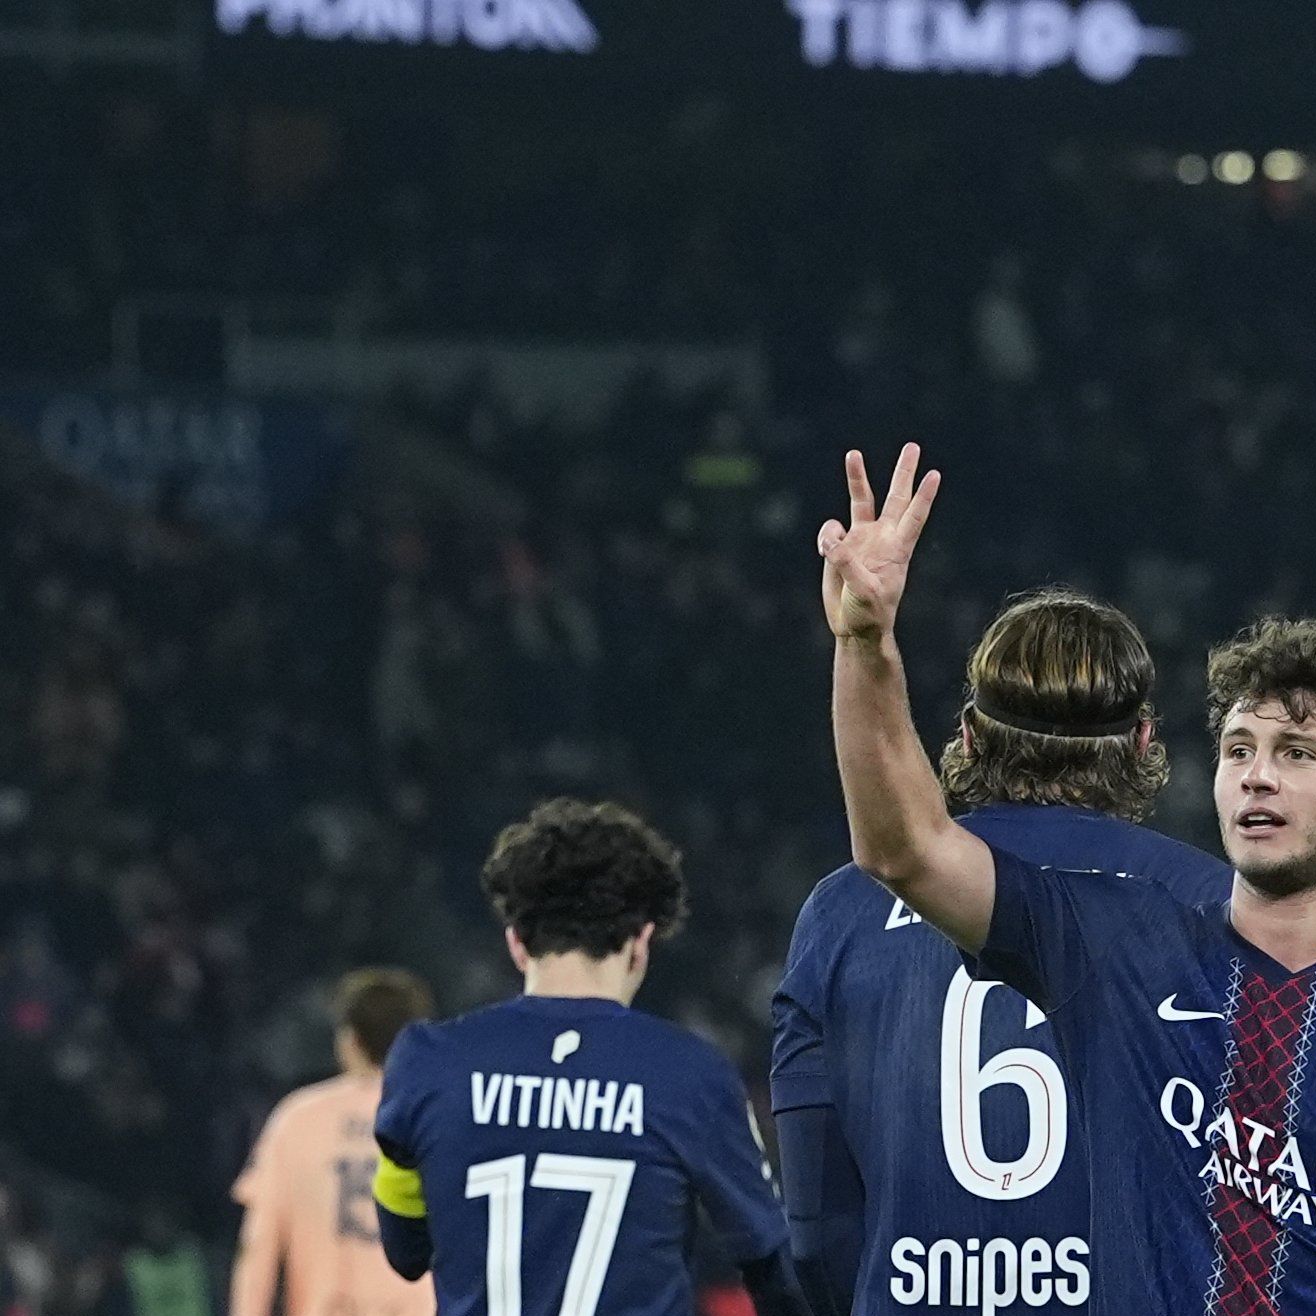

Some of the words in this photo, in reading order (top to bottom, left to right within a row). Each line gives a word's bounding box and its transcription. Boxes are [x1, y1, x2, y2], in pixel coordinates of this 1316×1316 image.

[787, 0, 1142, 81] TIEMPO
[471, 1071, 644, 1136] VITINHA
[940, 963, 1068, 1201] 6
